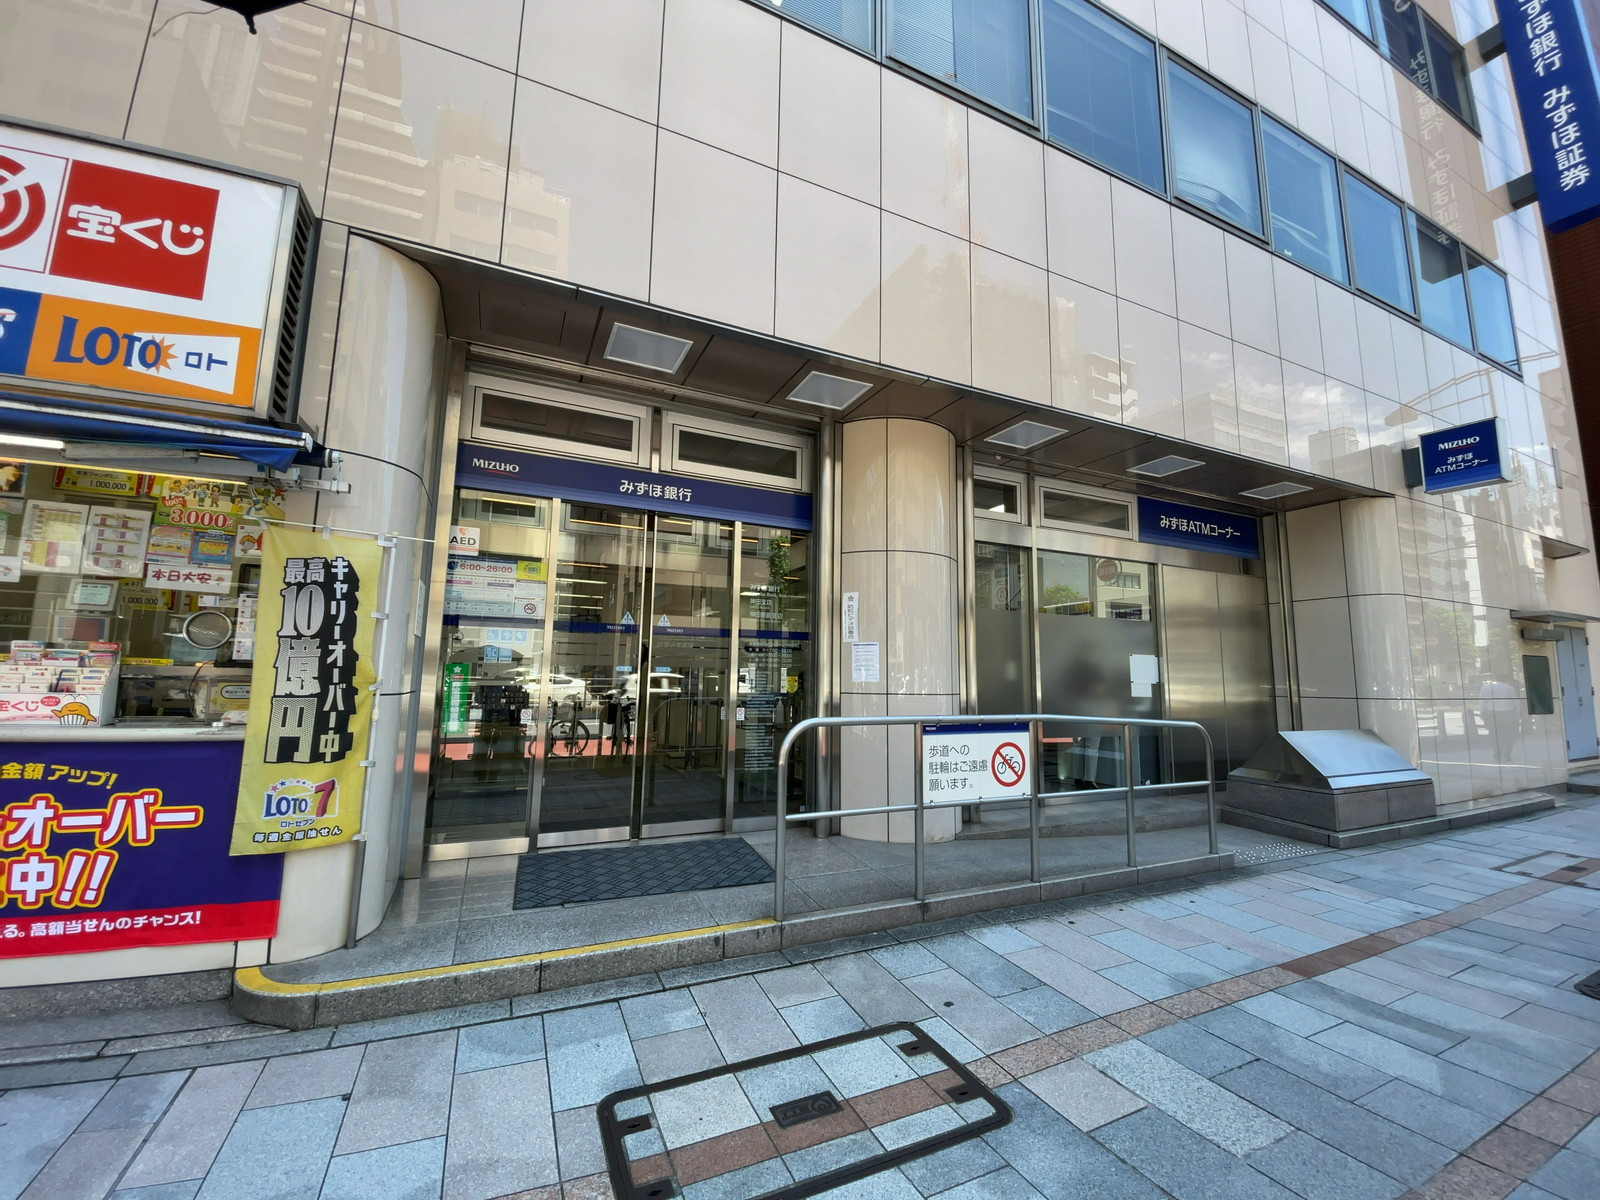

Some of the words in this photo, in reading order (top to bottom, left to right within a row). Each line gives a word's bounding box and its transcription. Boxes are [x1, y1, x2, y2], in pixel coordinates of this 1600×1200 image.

[1518, 0, 1562, 77] ずほ銀行
[1543, 85, 1590, 192] みずほ証券
[66, 204, 205, 256] 宝くじ
[52, 315, 162, 369] LOTO
[184, 350, 228, 372] ロト
[1438, 436, 1480, 451] MIZUHO
[472, 458, 520, 474] MIZUHO
[1447, 452, 1474, 463] みずほ
[1434, 459, 1489, 475] ATMコーナー
[619, 479, 692, 502] みずほ銀行
[1160, 515, 1241, 538] みずほATMコーナー
[450, 536, 477, 546] AED
[152, 569, 212, 585] 本日大安
[319, 556, 349, 763] キャリーオーバー中
[928, 744, 970, 758] 歩道への
[0, 762, 45, 780] 金額
[928, 759, 988, 775] 駐輪はご遠慮
[928, 777, 974, 792] 願います。
[263, 793, 309, 818] LOTO
[314, 778, 336, 818] 7
[0, 794, 196, 845] オーバー
[280, 818, 316, 828] ロトセブン
[0, 910, 202, 939] る。高額当せんのチャンス!
